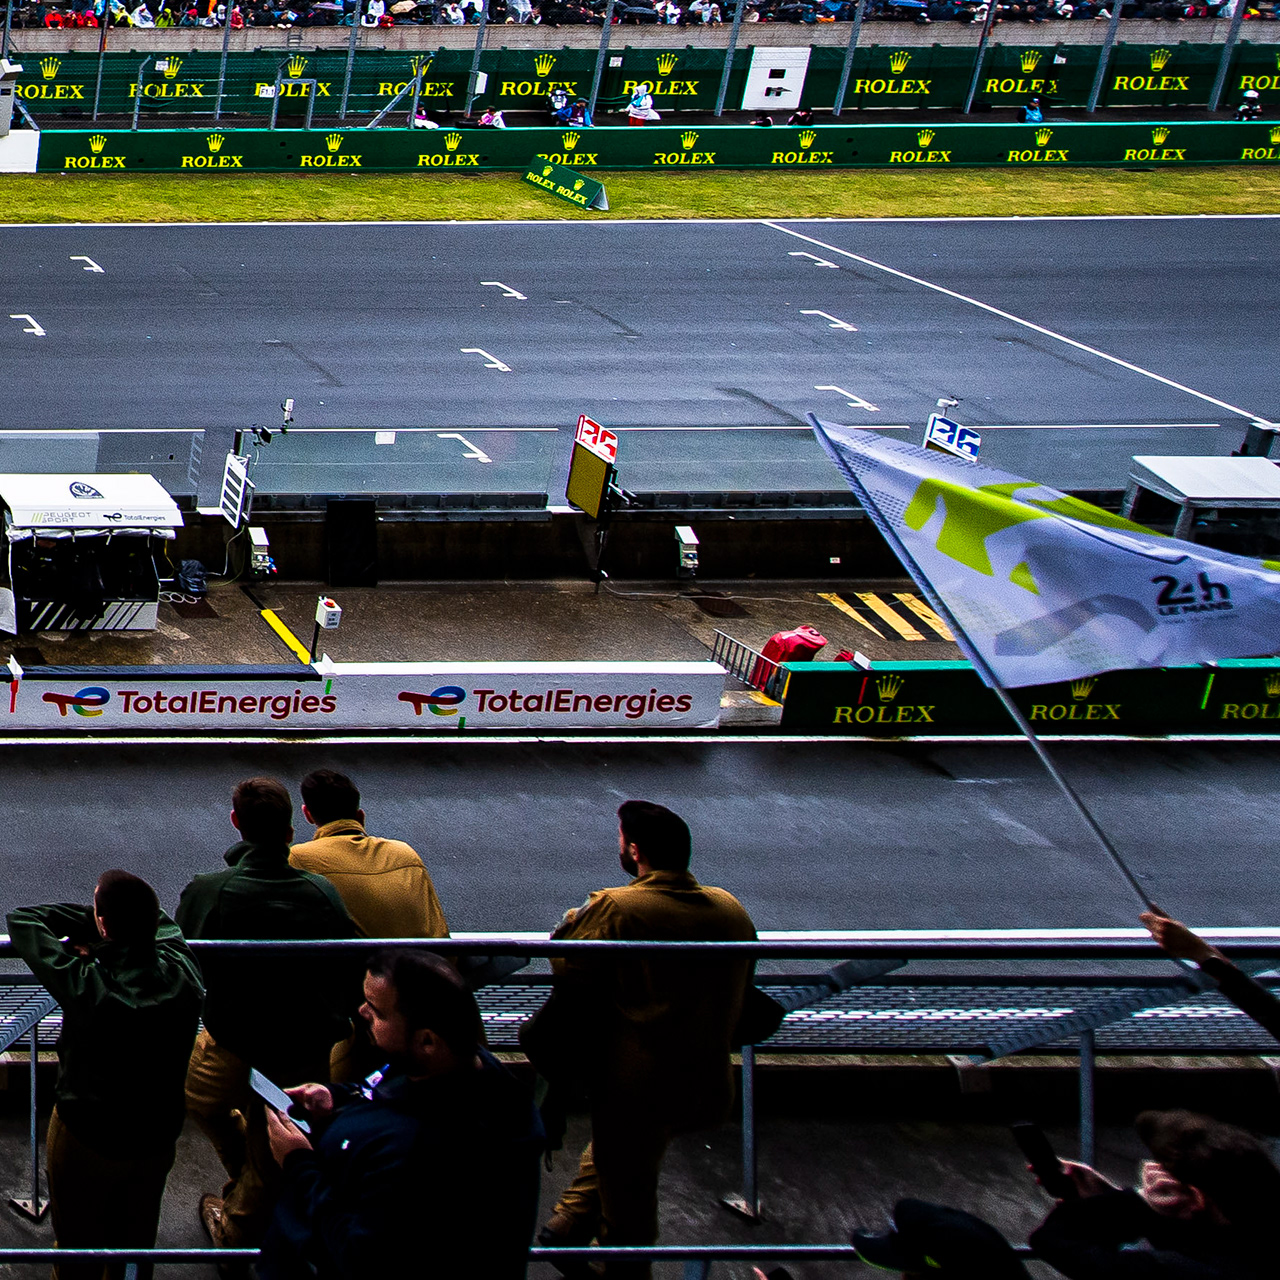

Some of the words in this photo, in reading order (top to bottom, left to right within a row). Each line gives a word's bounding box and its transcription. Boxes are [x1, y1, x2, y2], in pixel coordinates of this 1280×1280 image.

[855, 80, 931, 94] ROLEX
[1114, 76, 1189, 90] ROLEX
[16, 85, 84, 99] ROLEX
[301, 155, 361, 167] ROLEX
[418, 155, 479, 166] ROLEX
[654, 153, 715, 164] ROLEX
[772, 152, 833, 163] ROLEX
[890, 151, 951, 162] ROLEX
[1008, 150, 1069, 161] ROLEX
[1125, 149, 1186, 160] ROLEX
[65, 157, 126, 168] ROLEX
[182, 156, 242, 167] ROLEX
[526, 171, 556, 191] ROLEX
[556, 185, 589, 205] ROLEX
[935, 417, 981, 457] 36
[124, 514, 166, 522] TotalEnergies
[1159, 605, 1179, 615] LE
[1181, 601, 1234, 613] MANS
[118, 689, 337, 719] TotalEnergies
[473, 688, 692, 719] TotalEnergies
[833, 706, 935, 723] ROLEX
[1031, 704, 1120, 720] ROLEX
